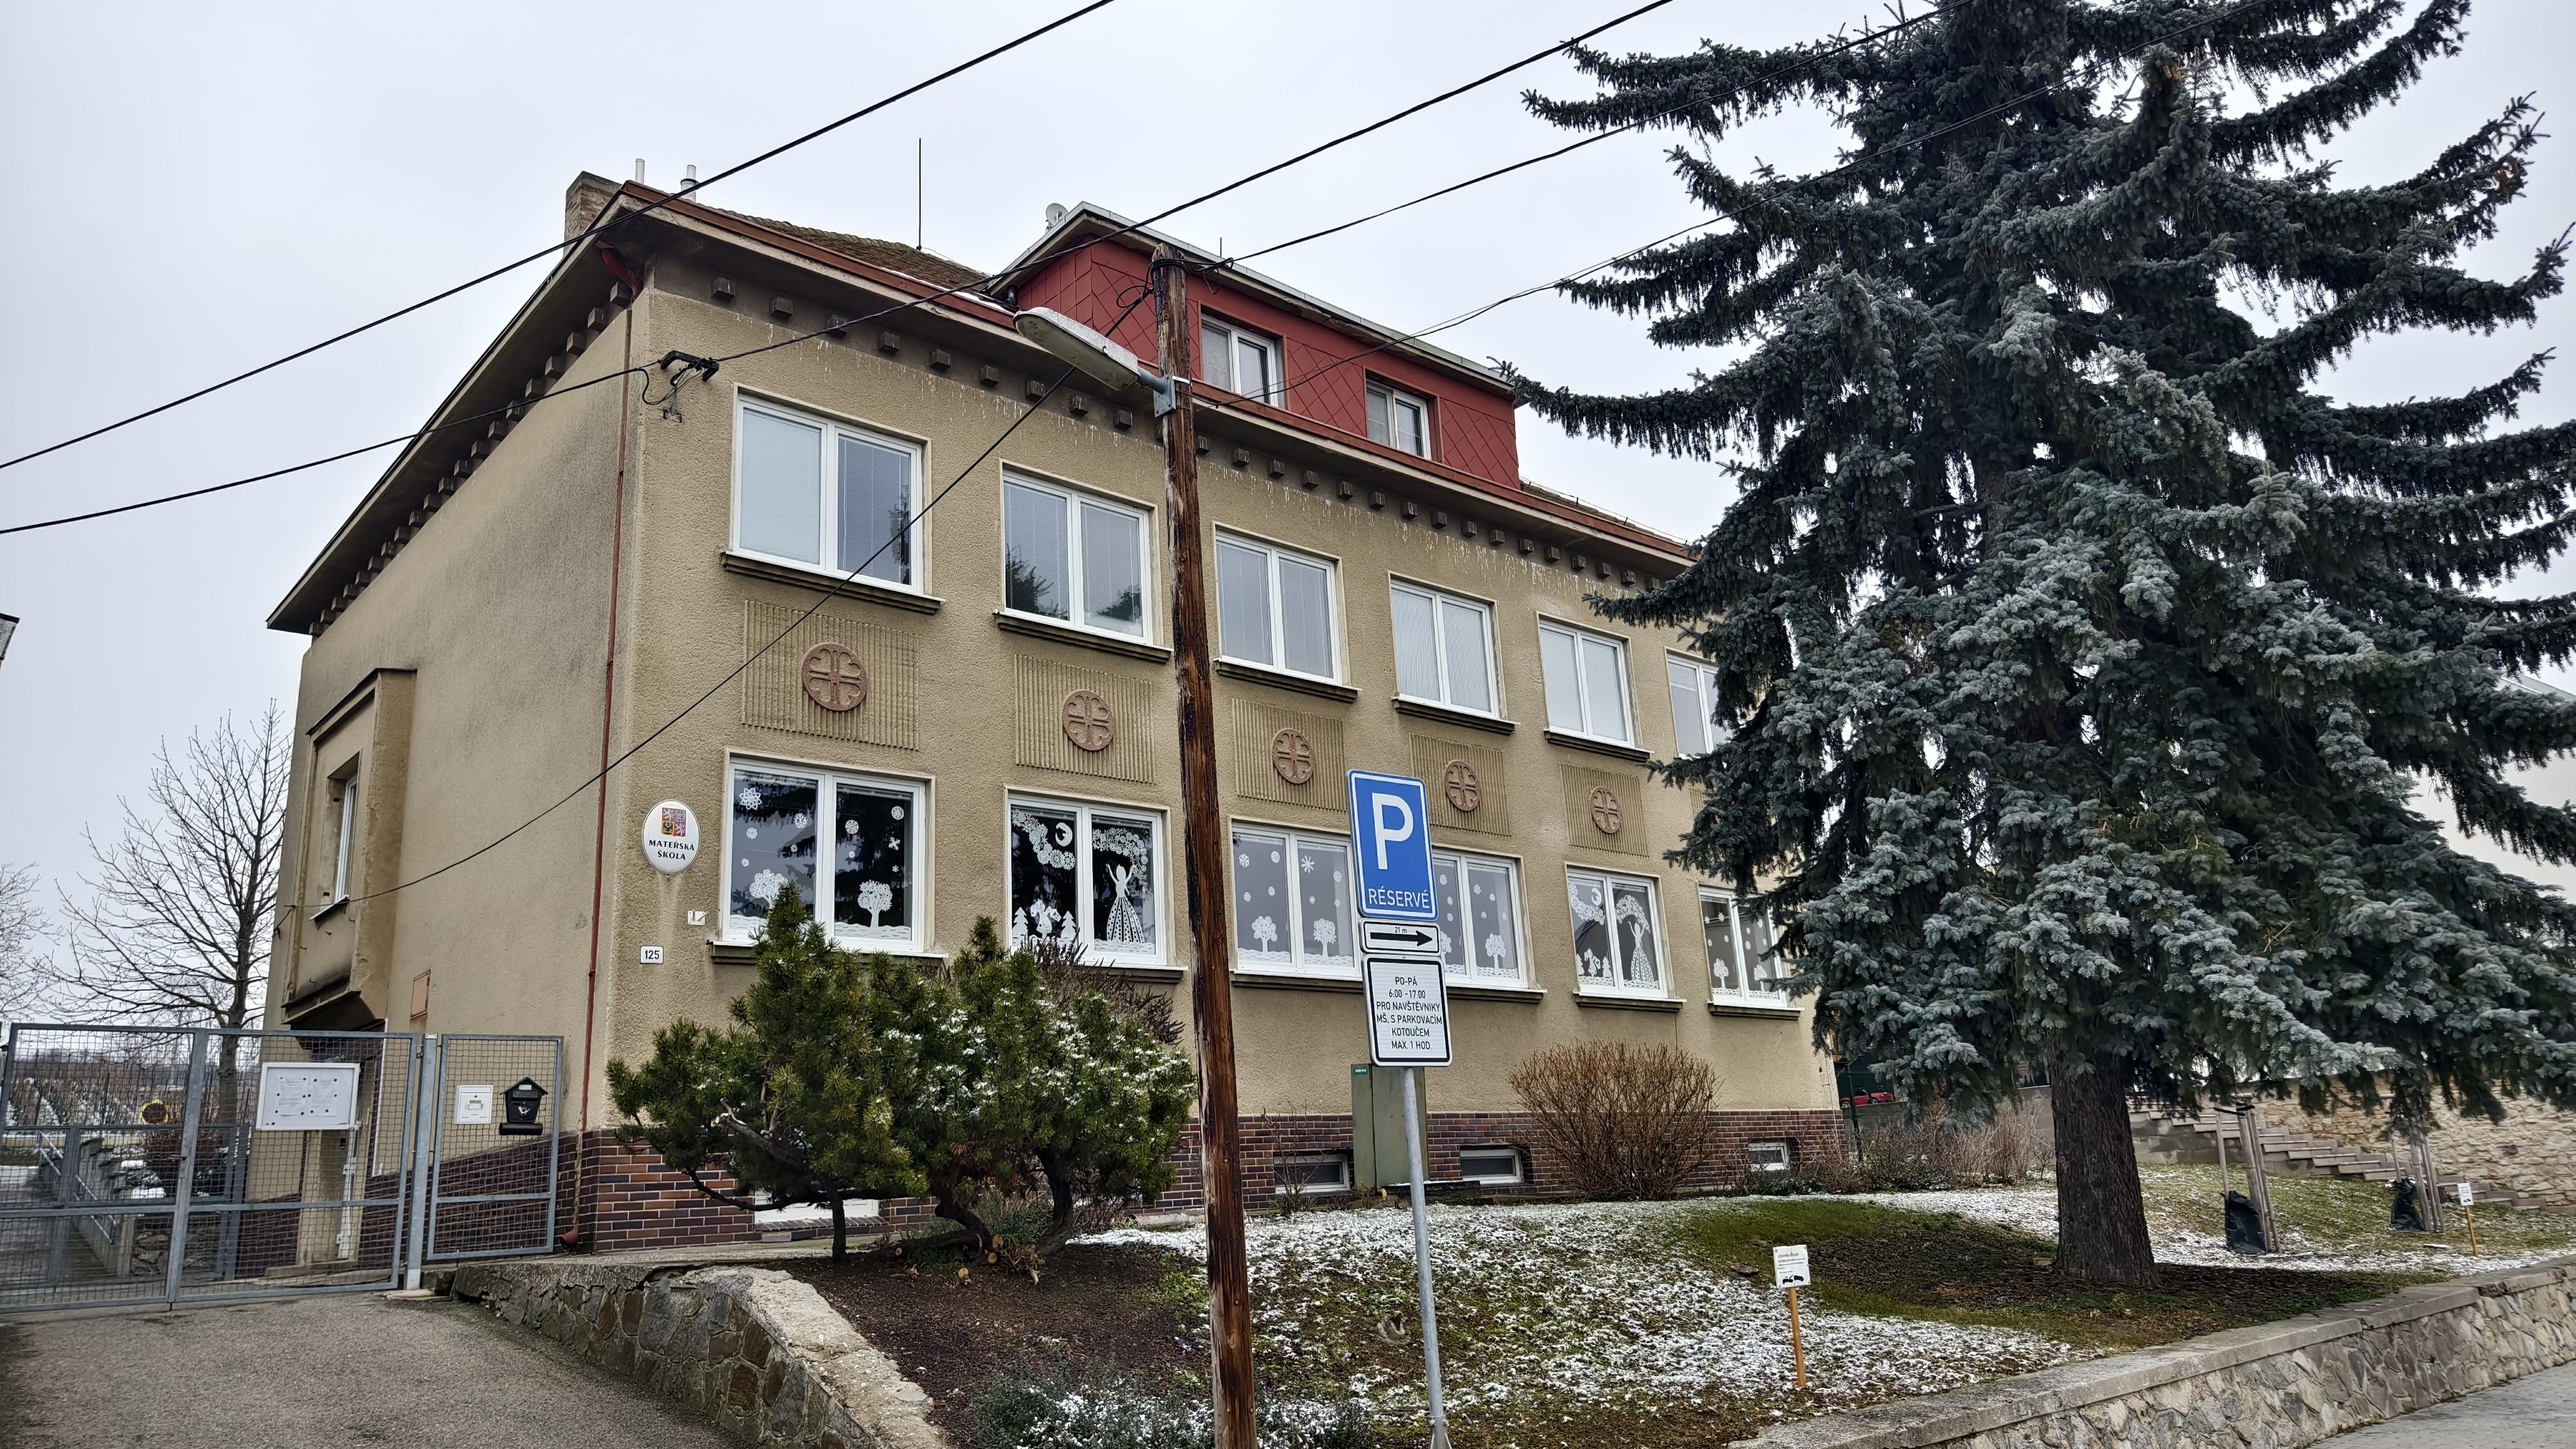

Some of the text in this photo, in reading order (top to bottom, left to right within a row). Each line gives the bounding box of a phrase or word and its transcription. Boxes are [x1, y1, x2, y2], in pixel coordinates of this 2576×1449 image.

[1372, 793, 1414, 870] P
[649, 840, 694, 851] MATEŘSKÁ
[657, 849, 686, 860] ŠKOLA
[1368, 886, 1430, 909] RÉSERVÉ
[645, 950, 659, 960] 125
[1395, 976, 1418, 986] PO-PÁ
[1388, 989, 1403, 998] 6:00
[1376, 1001, 1391, 1010] PRO
[1376, 1012, 1443, 1024] MŠ. S PARKOVACÍM
[1392, 1027, 1430, 1037] KOTOUČEM
[1391, 1041, 1432, 1050] MAX. 1 HOD.
